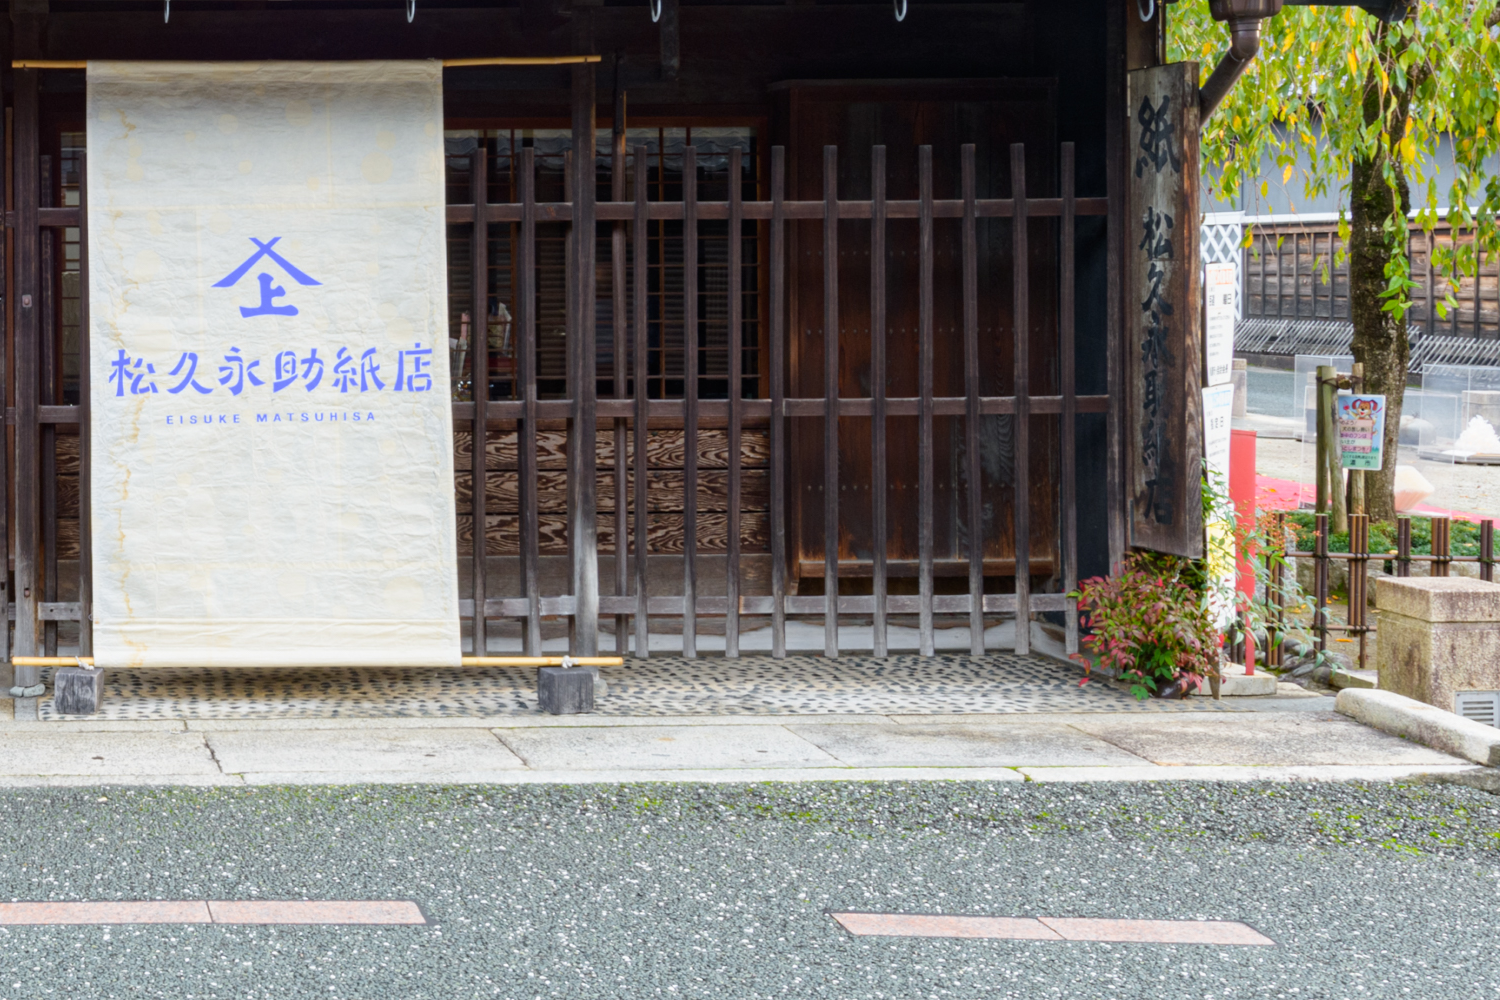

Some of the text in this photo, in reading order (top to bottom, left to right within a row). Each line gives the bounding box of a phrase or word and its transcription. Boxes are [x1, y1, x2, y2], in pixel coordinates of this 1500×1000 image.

[1135, 95, 1181, 178] 紙
[109, 342, 433, 397] 松久永助紙店
[166, 411, 376, 425] EISUKE MATSUHISA
